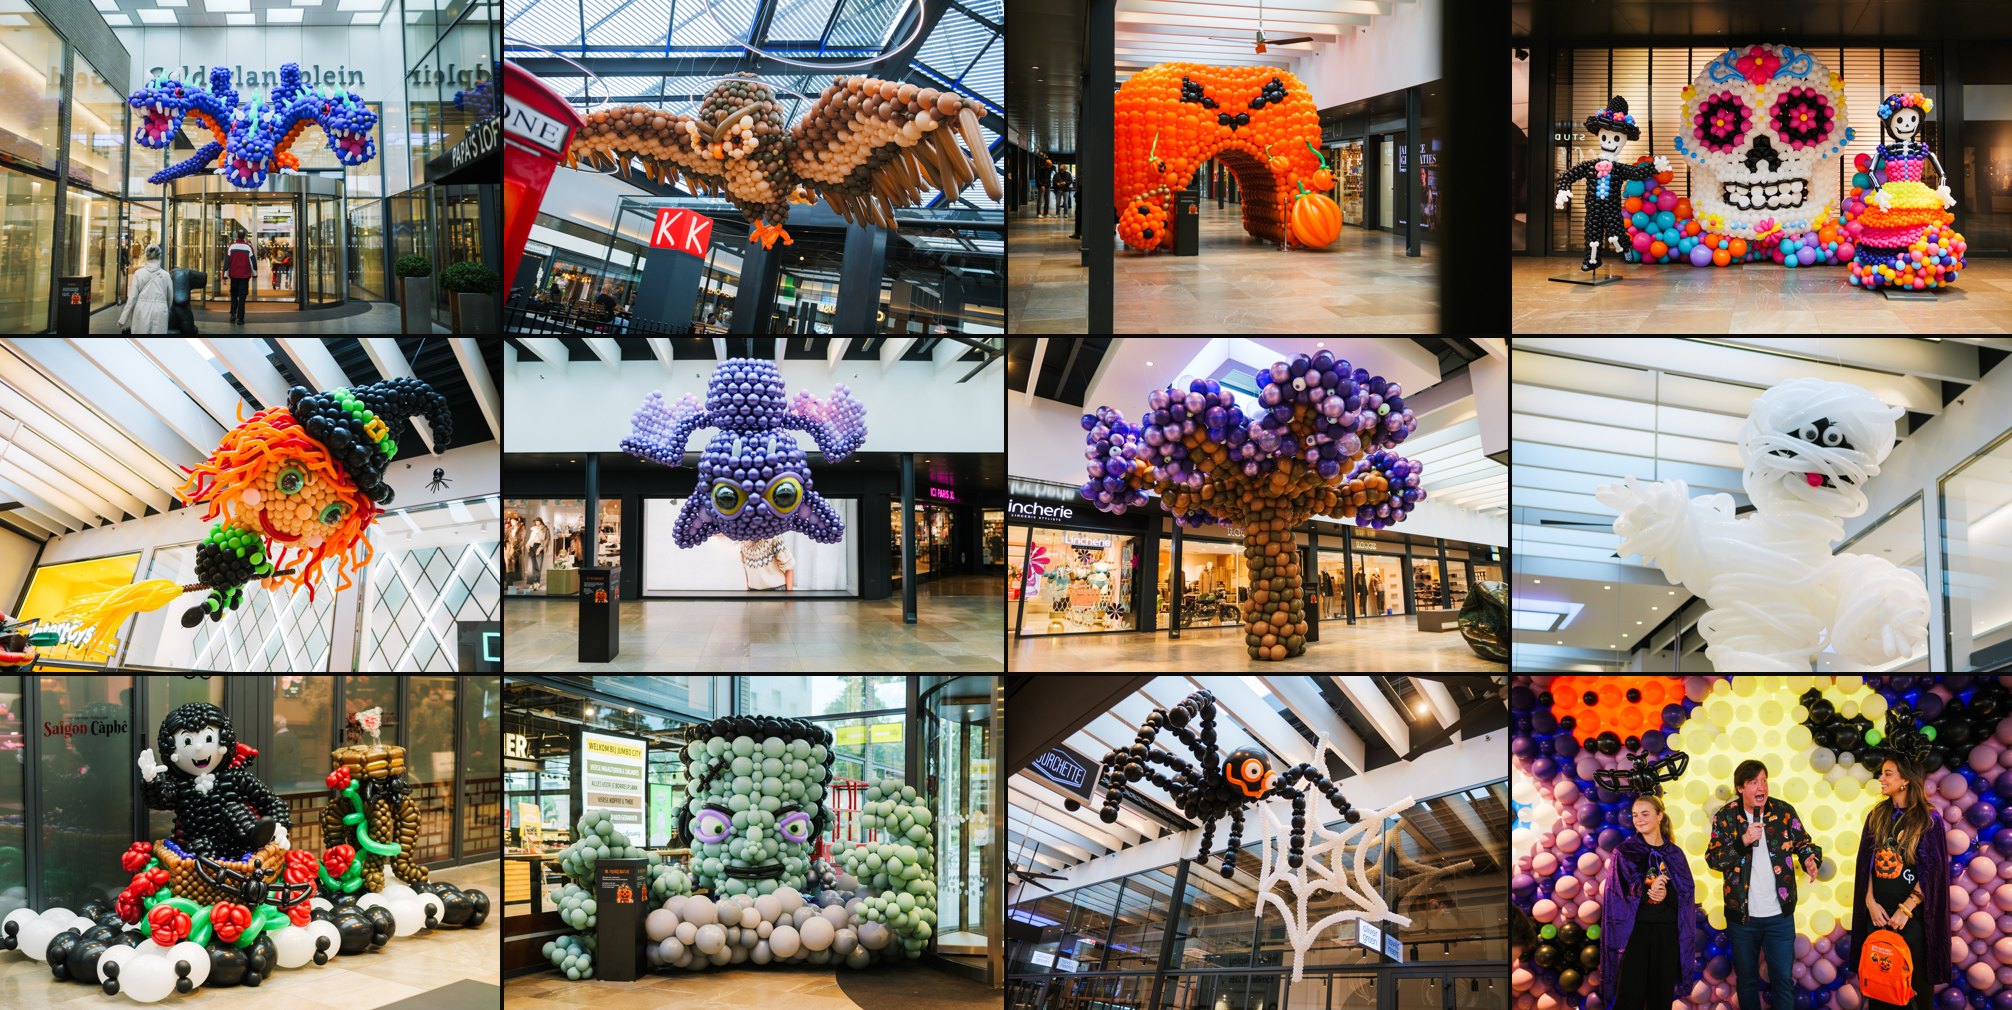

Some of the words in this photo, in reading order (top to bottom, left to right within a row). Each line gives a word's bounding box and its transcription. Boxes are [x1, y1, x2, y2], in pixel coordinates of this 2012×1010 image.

[452, 133, 478, 168] PAPA'S
[656, 211, 683, 246] K
[685, 215, 710, 254] K
[937, 488, 949, 499] PARIS
[949, 490, 955, 500] XL
[1008, 498, 1073, 519] incherie
[44, 721, 88, 739] Saigon
[91, 720, 128, 737] Càphê
[588, 742, 609, 752] WELKOM
[617, 747, 632, 756] JUMBO
[632, 750, 641, 758] CITY
[1362, 924, 1378, 936] oliver
[1362, 934, 1378, 946] green
